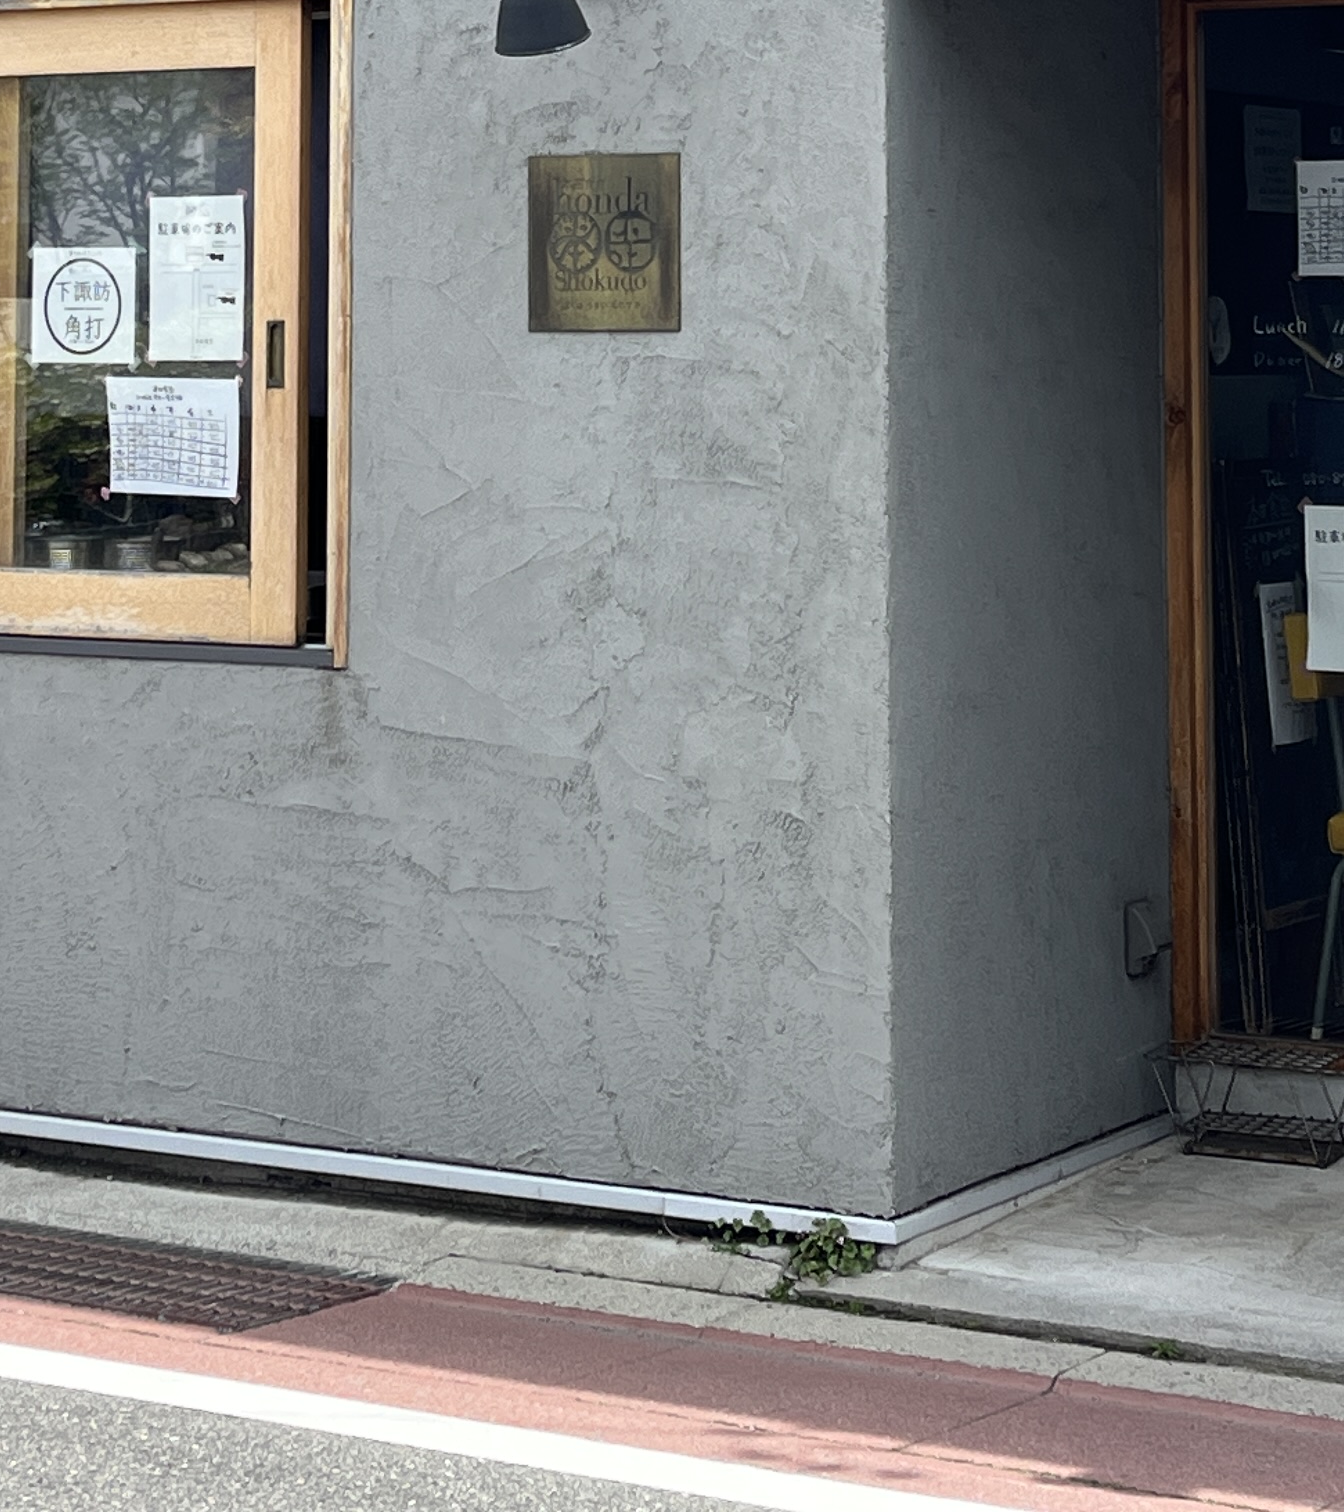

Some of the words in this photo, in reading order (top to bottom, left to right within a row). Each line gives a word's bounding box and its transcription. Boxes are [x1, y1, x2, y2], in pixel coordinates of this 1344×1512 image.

[157, 221, 237, 236] 駐車場のご案内
[55, 280, 112, 303] 下諏訪
[64, 314, 105, 340] 角打
[1253, 315, 1307, 335] Lunch
